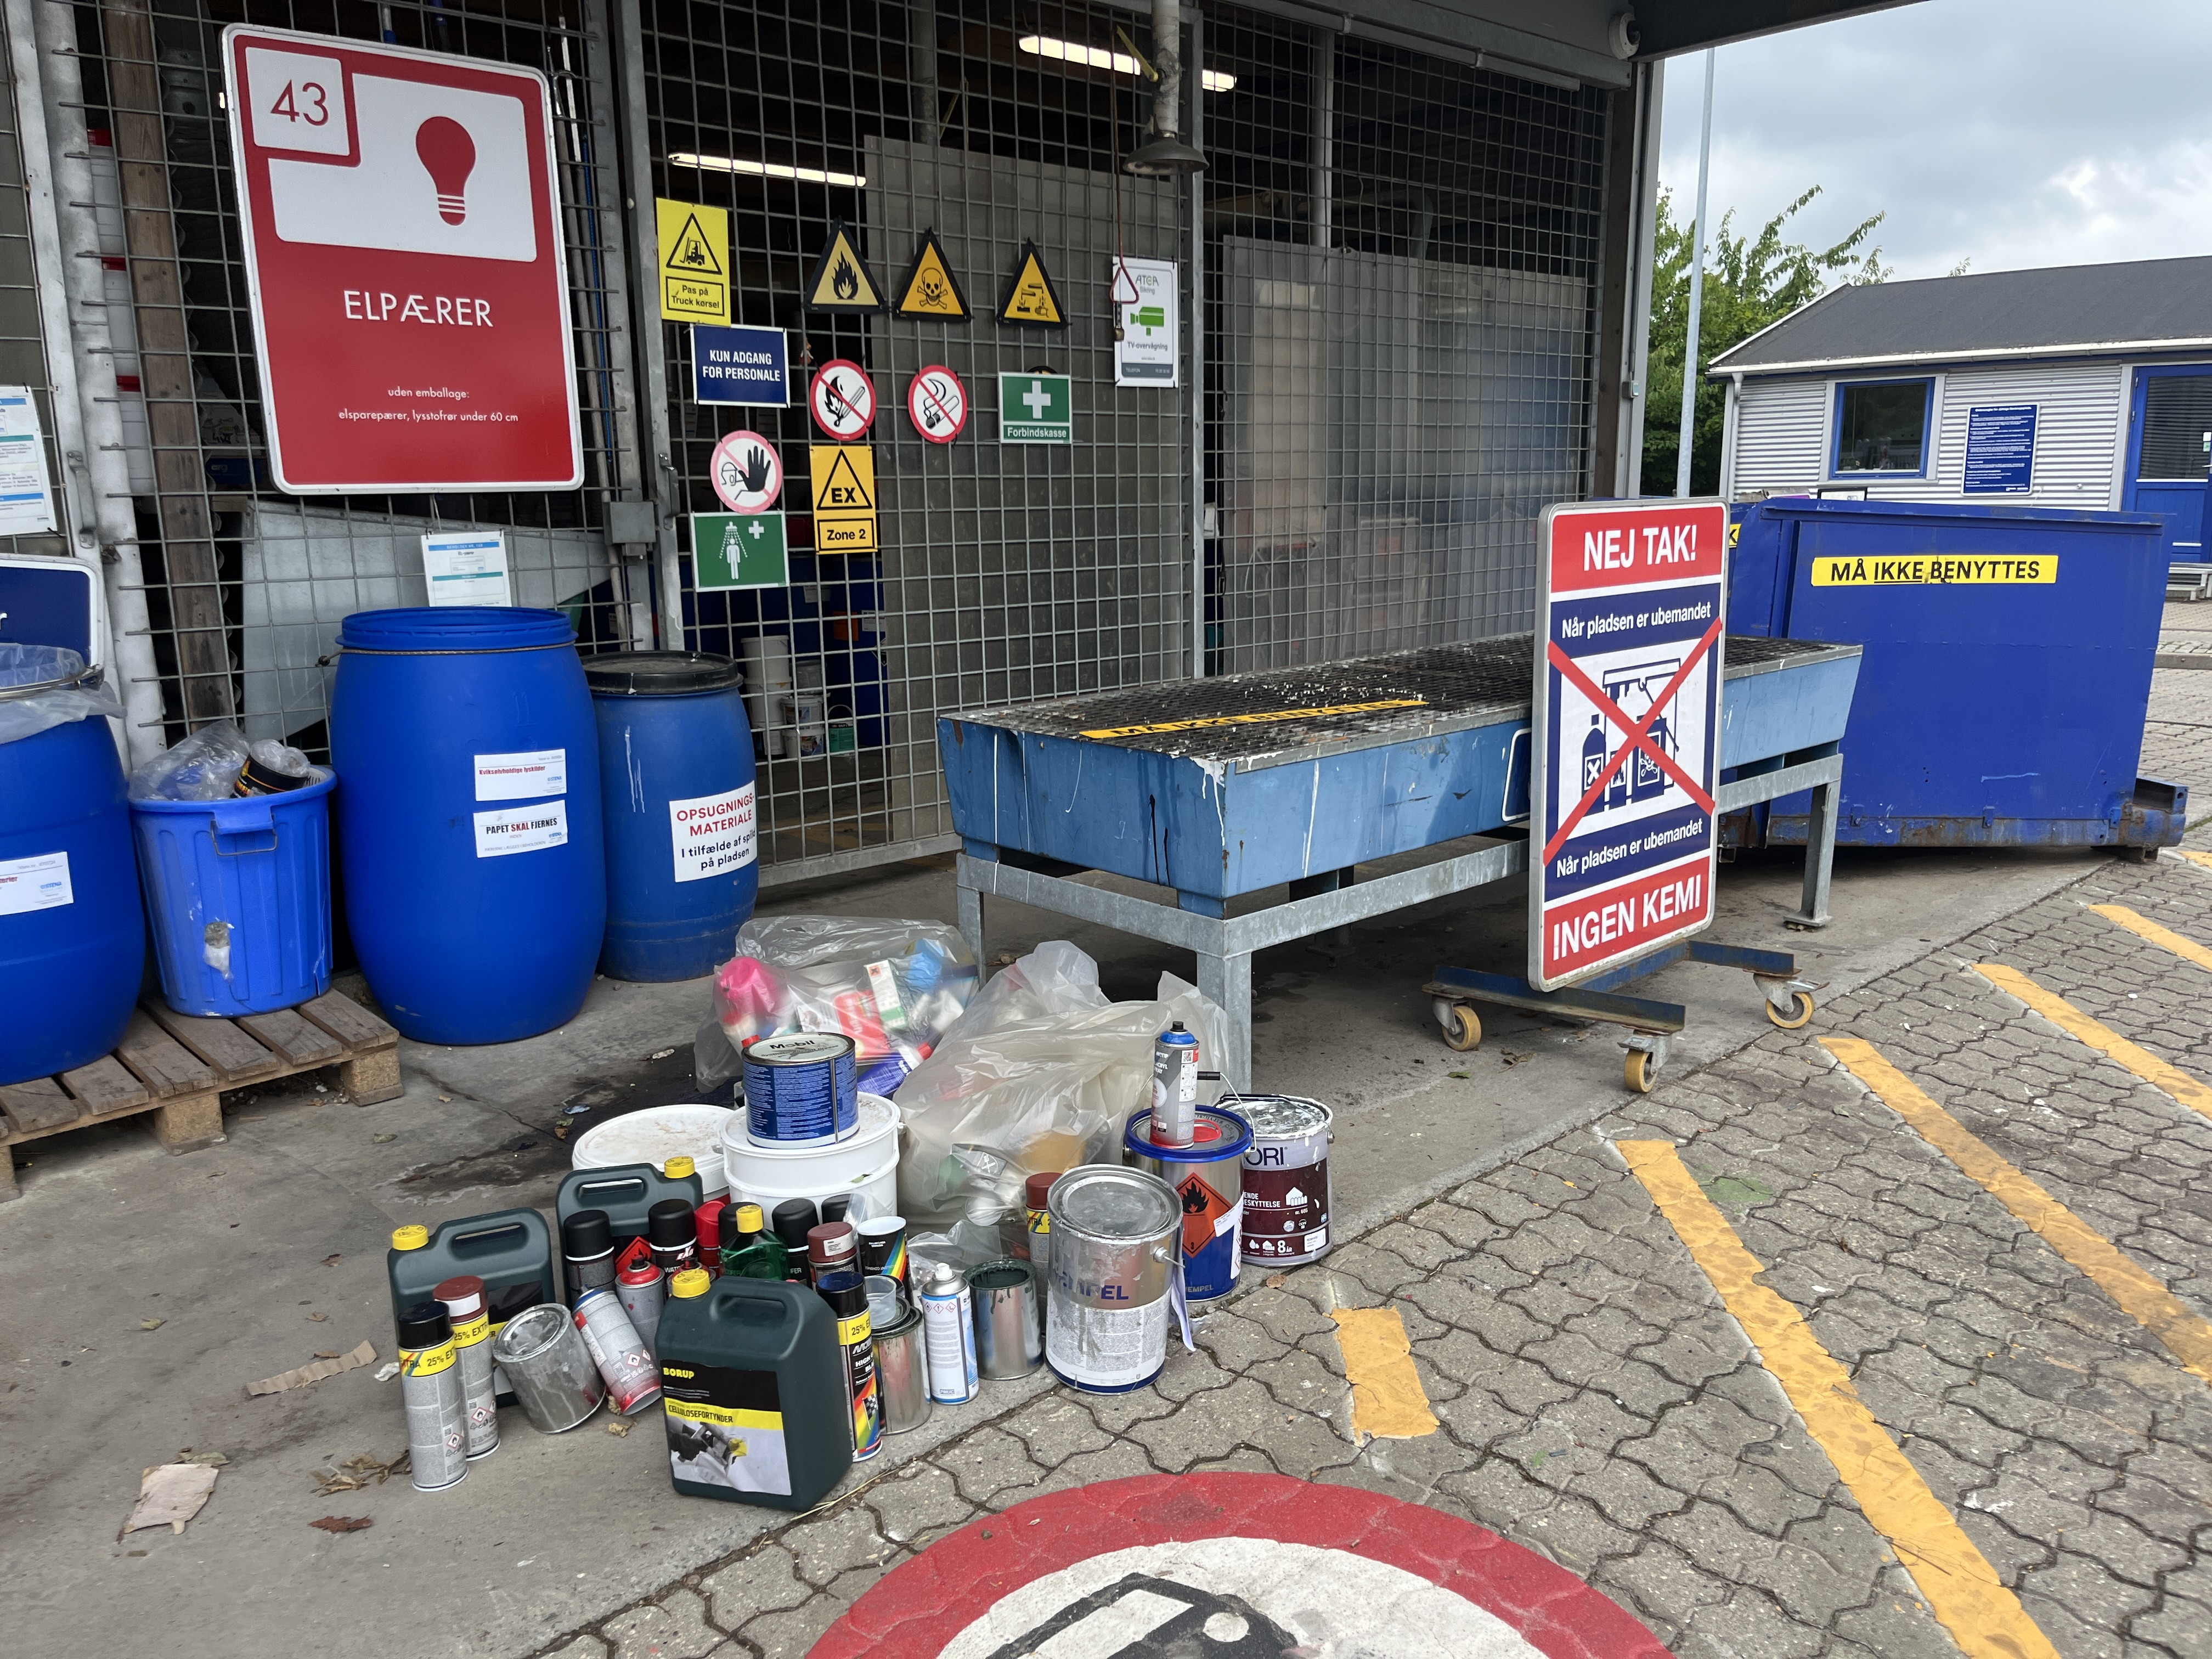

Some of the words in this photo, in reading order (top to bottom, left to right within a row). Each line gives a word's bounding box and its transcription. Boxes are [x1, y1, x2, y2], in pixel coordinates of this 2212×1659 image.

[270, 79, 329, 126] 43
[682, 284, 697, 295] Pas
[698, 286, 709, 296] på
[343, 289, 493, 328] ELPÆRER
[672, 295, 694, 307] Truck
[696, 297, 719, 309] kørsel
[709, 349, 730, 363] KUN
[733, 351, 772, 365] ADGANG
[702, 366, 723, 379] FOR
[725, 366, 781, 382] PERSONALE
[388, 386, 414, 398] uden
[416, 386, 470, 401] emballage:
[338, 409, 410, 425] elsparepærer,
[412, 409, 458, 425] lysstofrør
[460, 411, 488, 422] under
[490, 412, 503, 422] 60
[505, 414, 519, 422] cm
[1007, 426, 1067, 439] Forbindskasse
[831, 487, 857, 504] EX
[827, 529, 856, 541] Zone
[859, 528, 866, 540] 2
[1583, 528, 1635, 572] NEJ
[1643, 524, 1697, 566] TAK!
[1831, 559, 1866, 581] MÅ
[1874, 562, 1923, 581] IKKE
[1930, 560, 2040, 580] BENYTTES
[1562, 617, 1585, 639] Når
[1587, 613, 1633, 639] pladsen
[1637, 613, 1649, 627] er
[1651, 601, 1711, 627] ubemandet
[1111, 725, 1170, 736] MÅ
[1175, 718, 1250, 729] IKKE
[1251, 702, 1403, 720] BENYTTES
[676, 792, 755, 822] OPSUGNINGS-
[486, 825, 510, 834] PAPET
[511, 822, 530, 832] SKAL
[531, 817, 557, 830] FJERNES
[690, 809, 752, 837] MATERIALE
[681, 848, 685, 858] I
[689, 840, 731, 857] tilfælde
[733, 835, 741, 847] af
[1556, 855, 1579, 878] Når
[1581, 844, 1627, 874] pladsen
[1629, 839, 1642, 855] er
[1644, 818, 1703, 850] ubemandet
[701, 857, 714, 871] på
[718, 848, 749, 867] pladsen
[1553, 897, 1635, 961] INGEN
[1642, 874, 1701, 928] KEMI
[770, 1040, 816, 1049] Mobil
[1244, 1146, 1284, 1166] ORI
[1244, 1191, 1259, 1200] ENDE
[1244, 1198, 1280, 1207] ESKYTTELSE
[1190, 1242, 1194, 1250] 3
[1277, 1240, 1286, 1254] 8
[454, 1331, 470, 1341] 25%
[851, 1322, 866, 1336] 25%
[427, 1356, 444, 1367] 25%
[855, 1356, 871, 1368] HIGH
[663, 1367, 695, 1379] BORUP
[668, 1404, 733, 1424] CELLULOSEFORTYNDER
